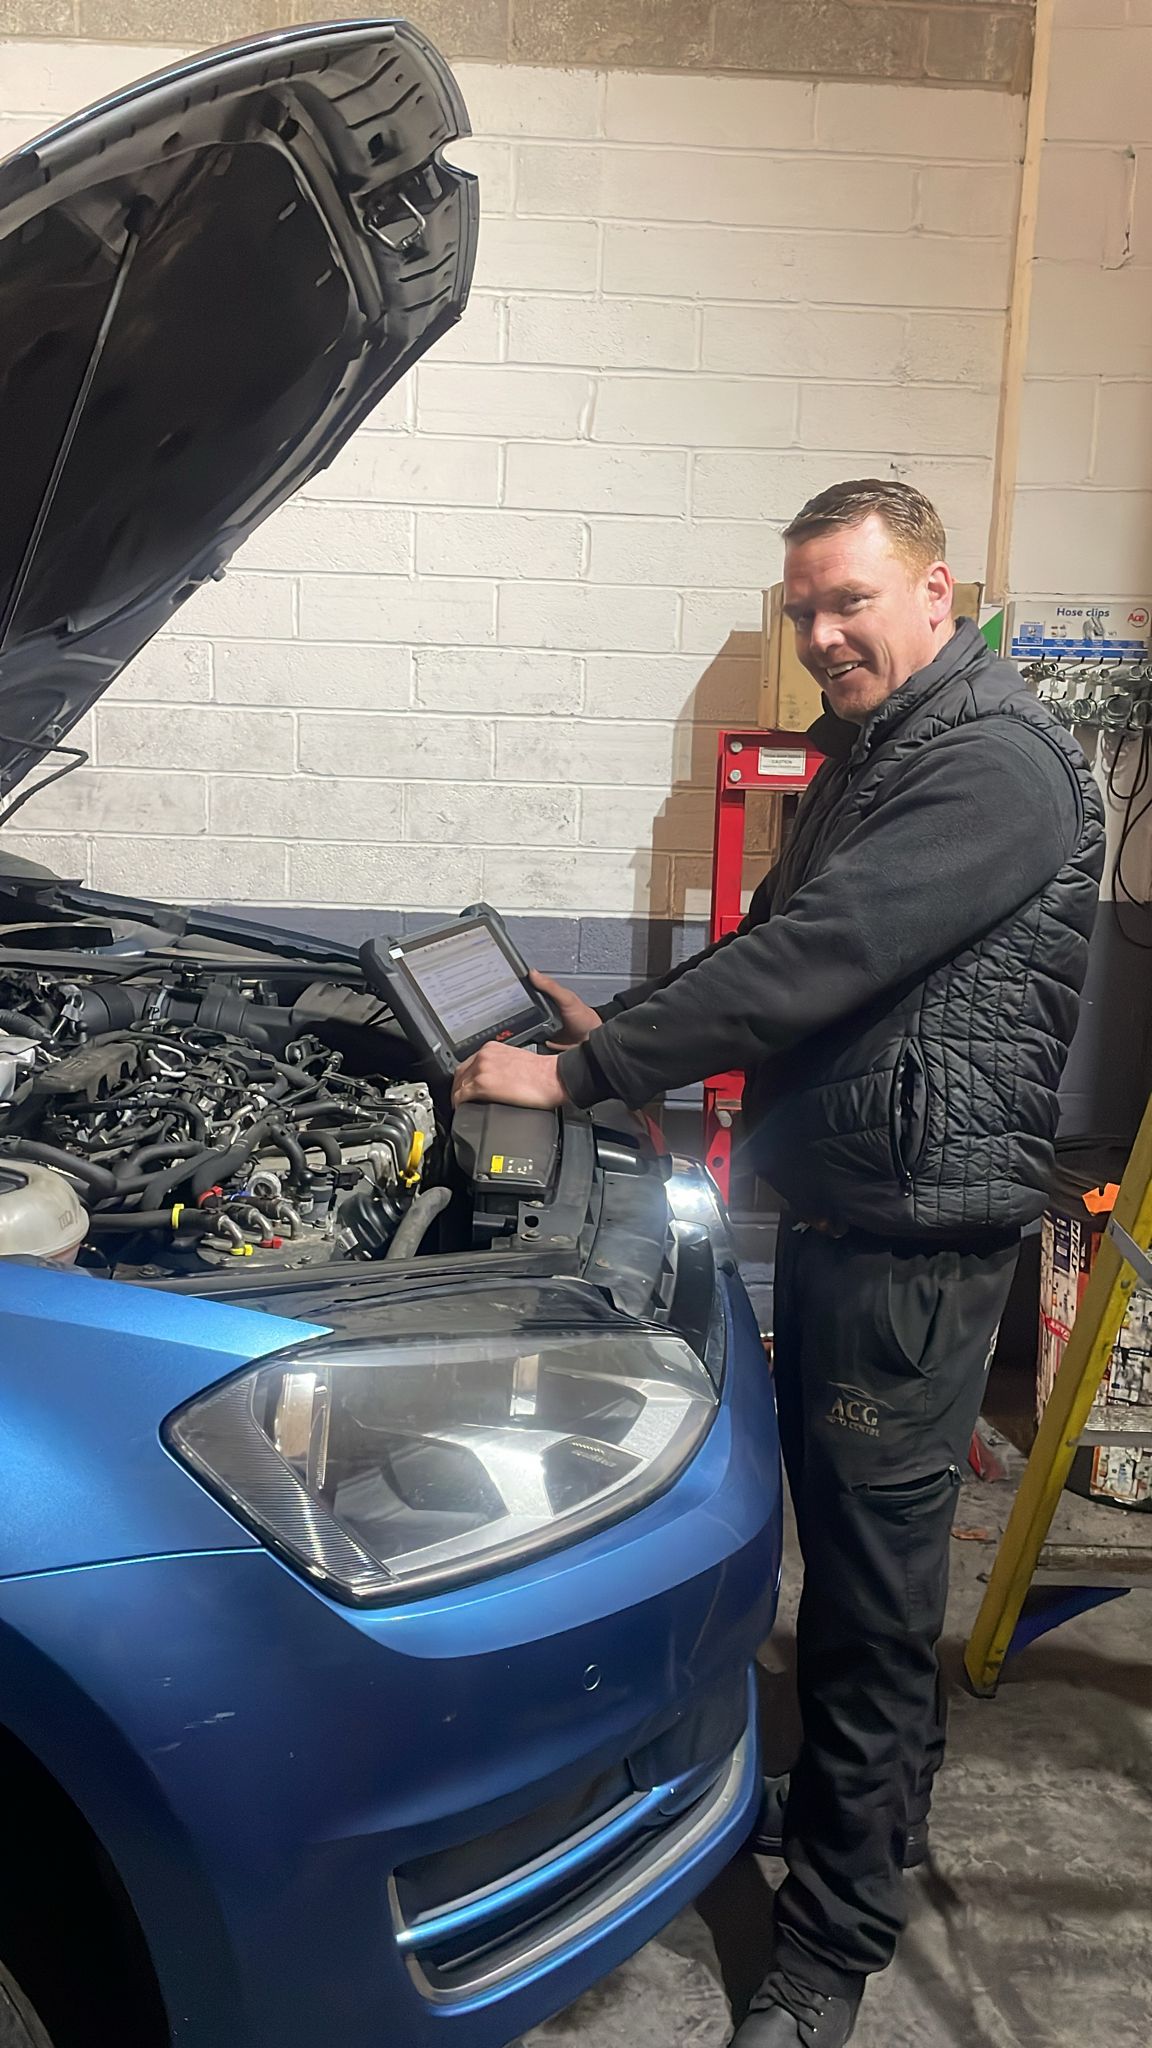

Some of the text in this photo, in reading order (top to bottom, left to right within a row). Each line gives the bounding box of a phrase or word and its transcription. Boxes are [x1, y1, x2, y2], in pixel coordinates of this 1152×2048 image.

[1056, 607, 1110, 619] Hose clips
[831, 1397, 879, 1426] ACG
